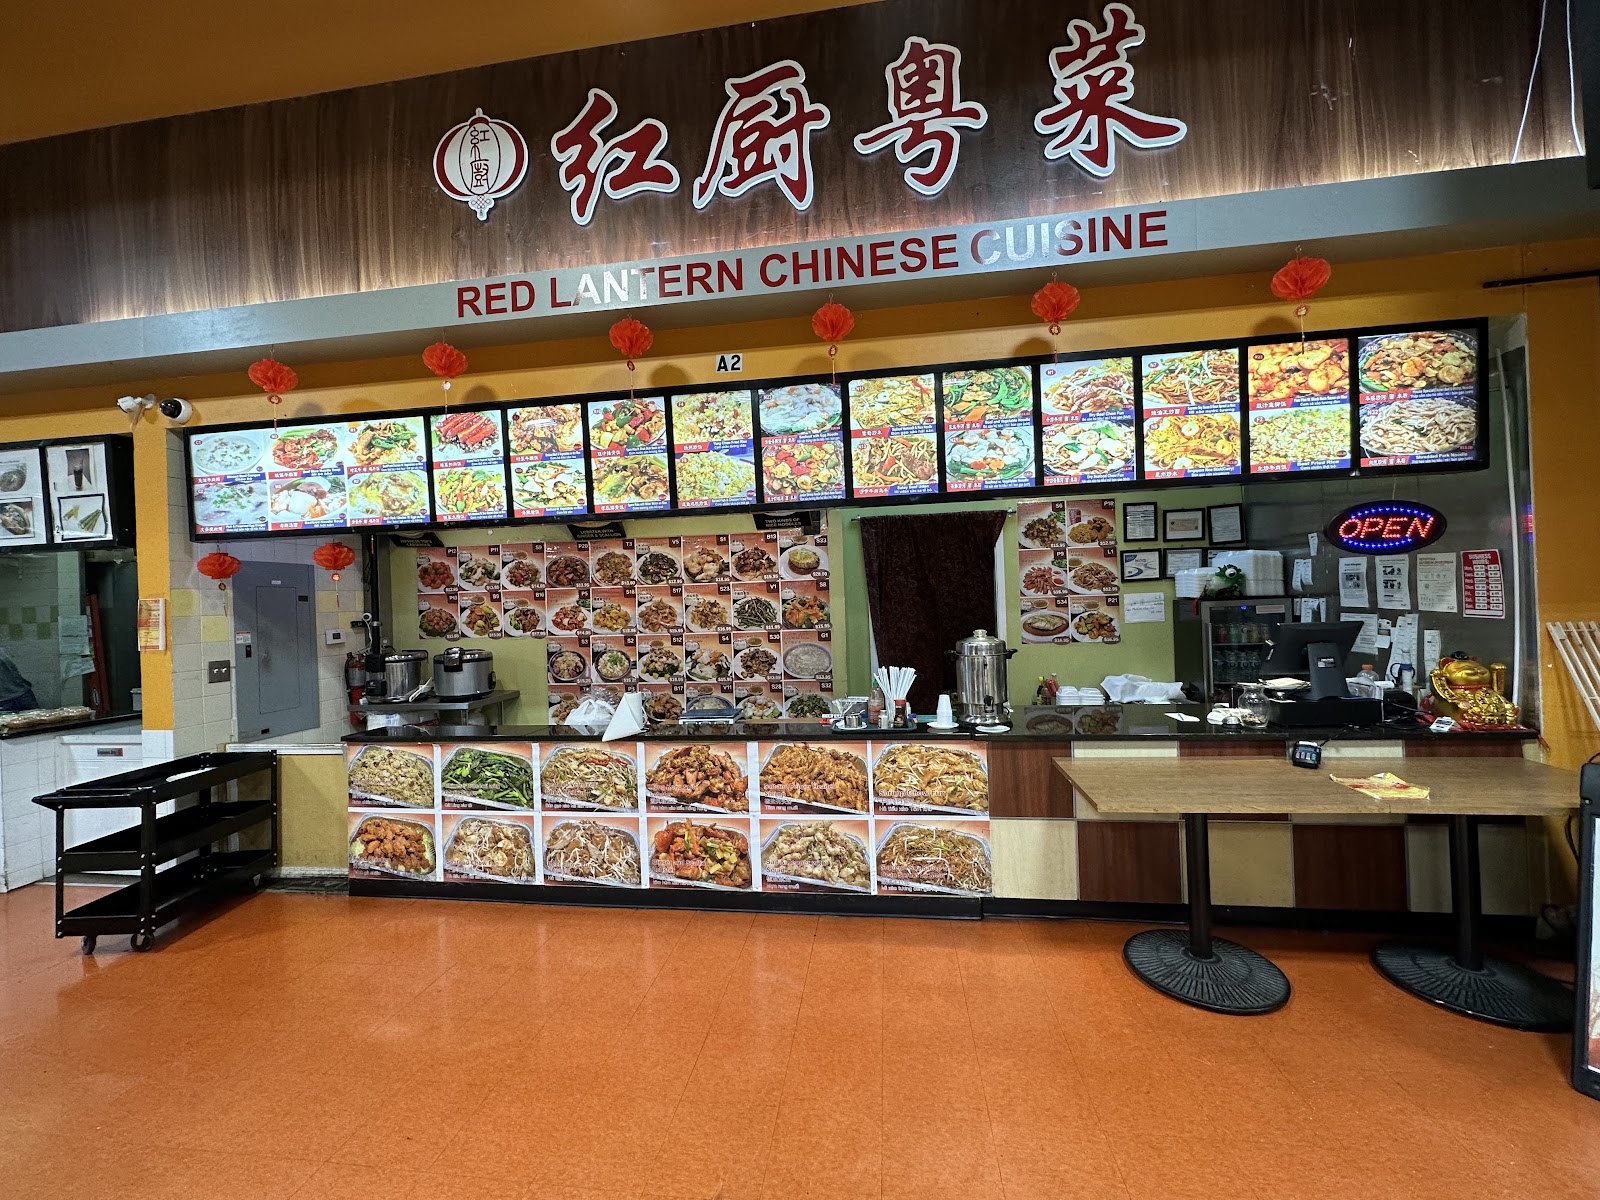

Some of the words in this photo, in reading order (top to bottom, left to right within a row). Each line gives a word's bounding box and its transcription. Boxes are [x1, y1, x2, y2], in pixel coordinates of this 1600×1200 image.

[549, 2, 1188, 226] 红厨粤菜
[457, 285, 536, 318] RED
[549, 256, 745, 308] LANTERN
[758, 231, 958, 287] CHINESE
[968, 210, 1168, 265] CUISINE
[716, 354, 741, 372] A2
[1338, 515, 1435, 540] OPEN
